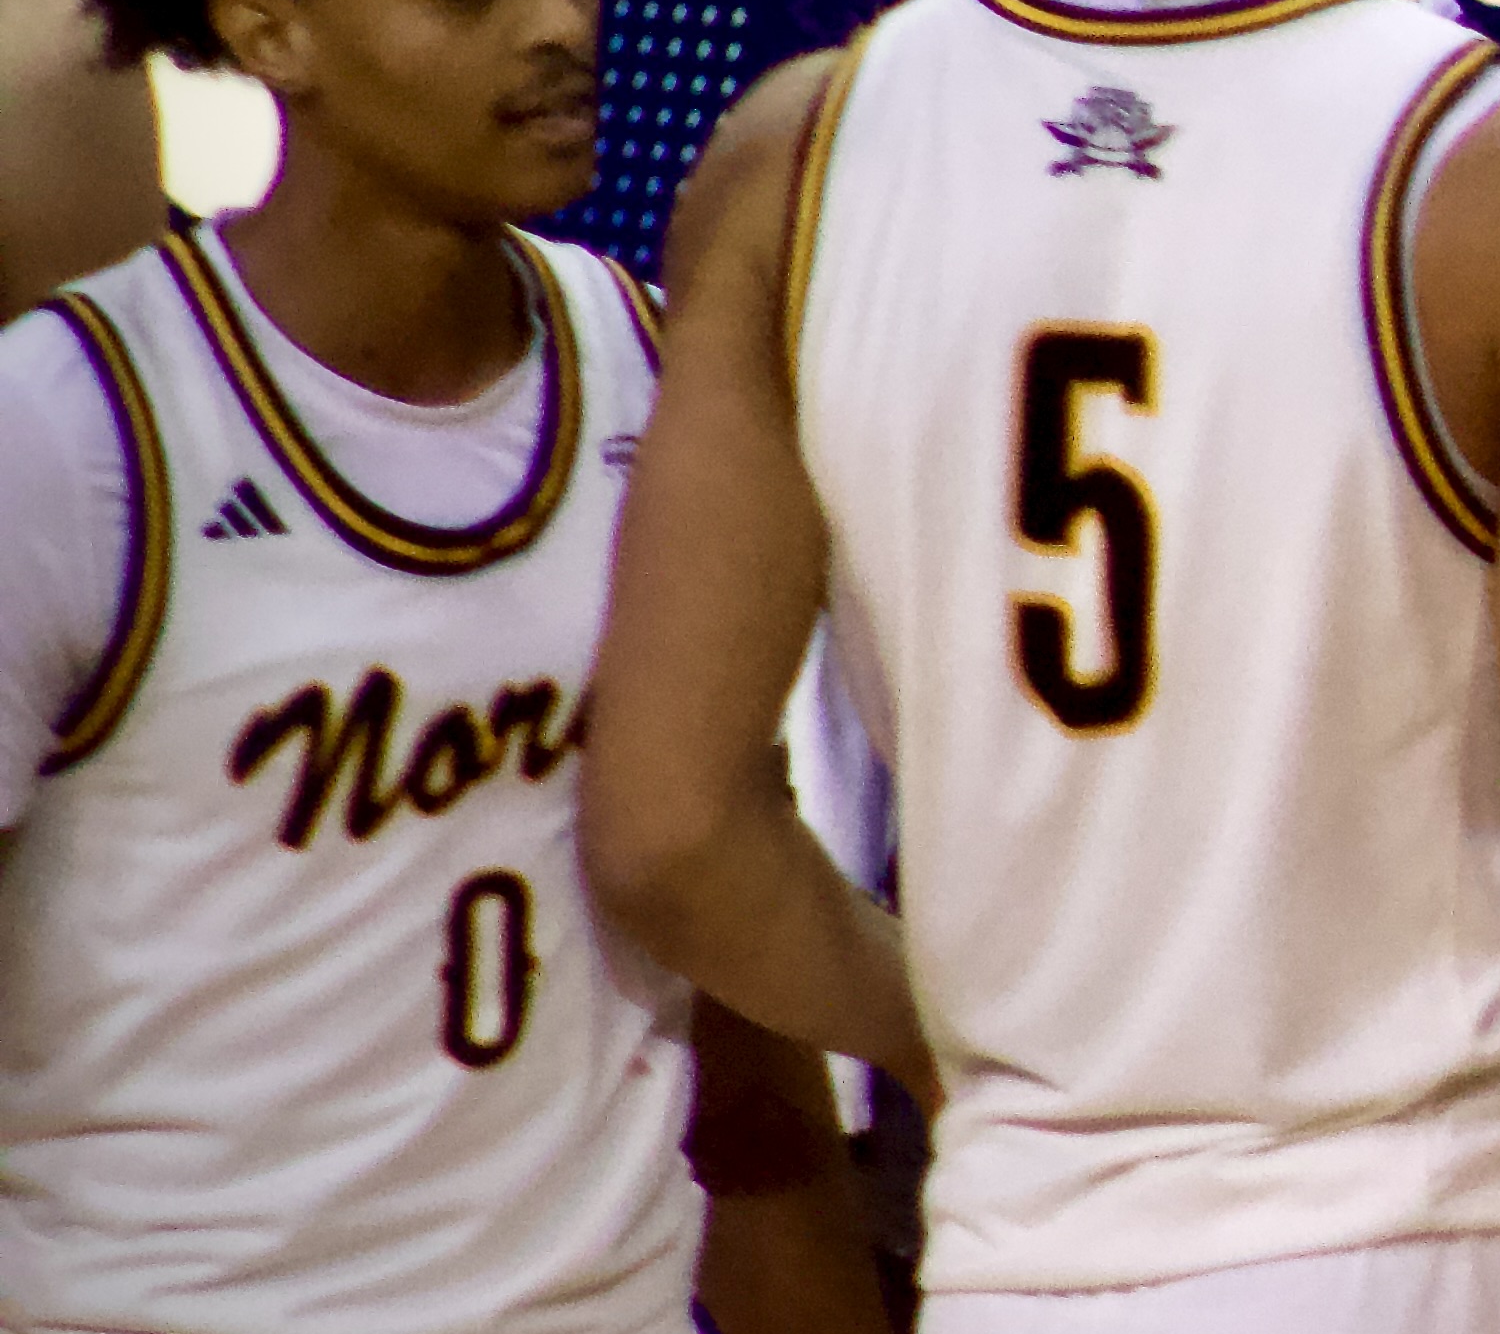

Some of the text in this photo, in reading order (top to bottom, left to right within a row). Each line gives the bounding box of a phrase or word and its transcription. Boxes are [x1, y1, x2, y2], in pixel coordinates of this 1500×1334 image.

[1010, 319, 1162, 739] 5
[226, 663, 588, 852] Nor
[438, 867, 540, 1070] 0
